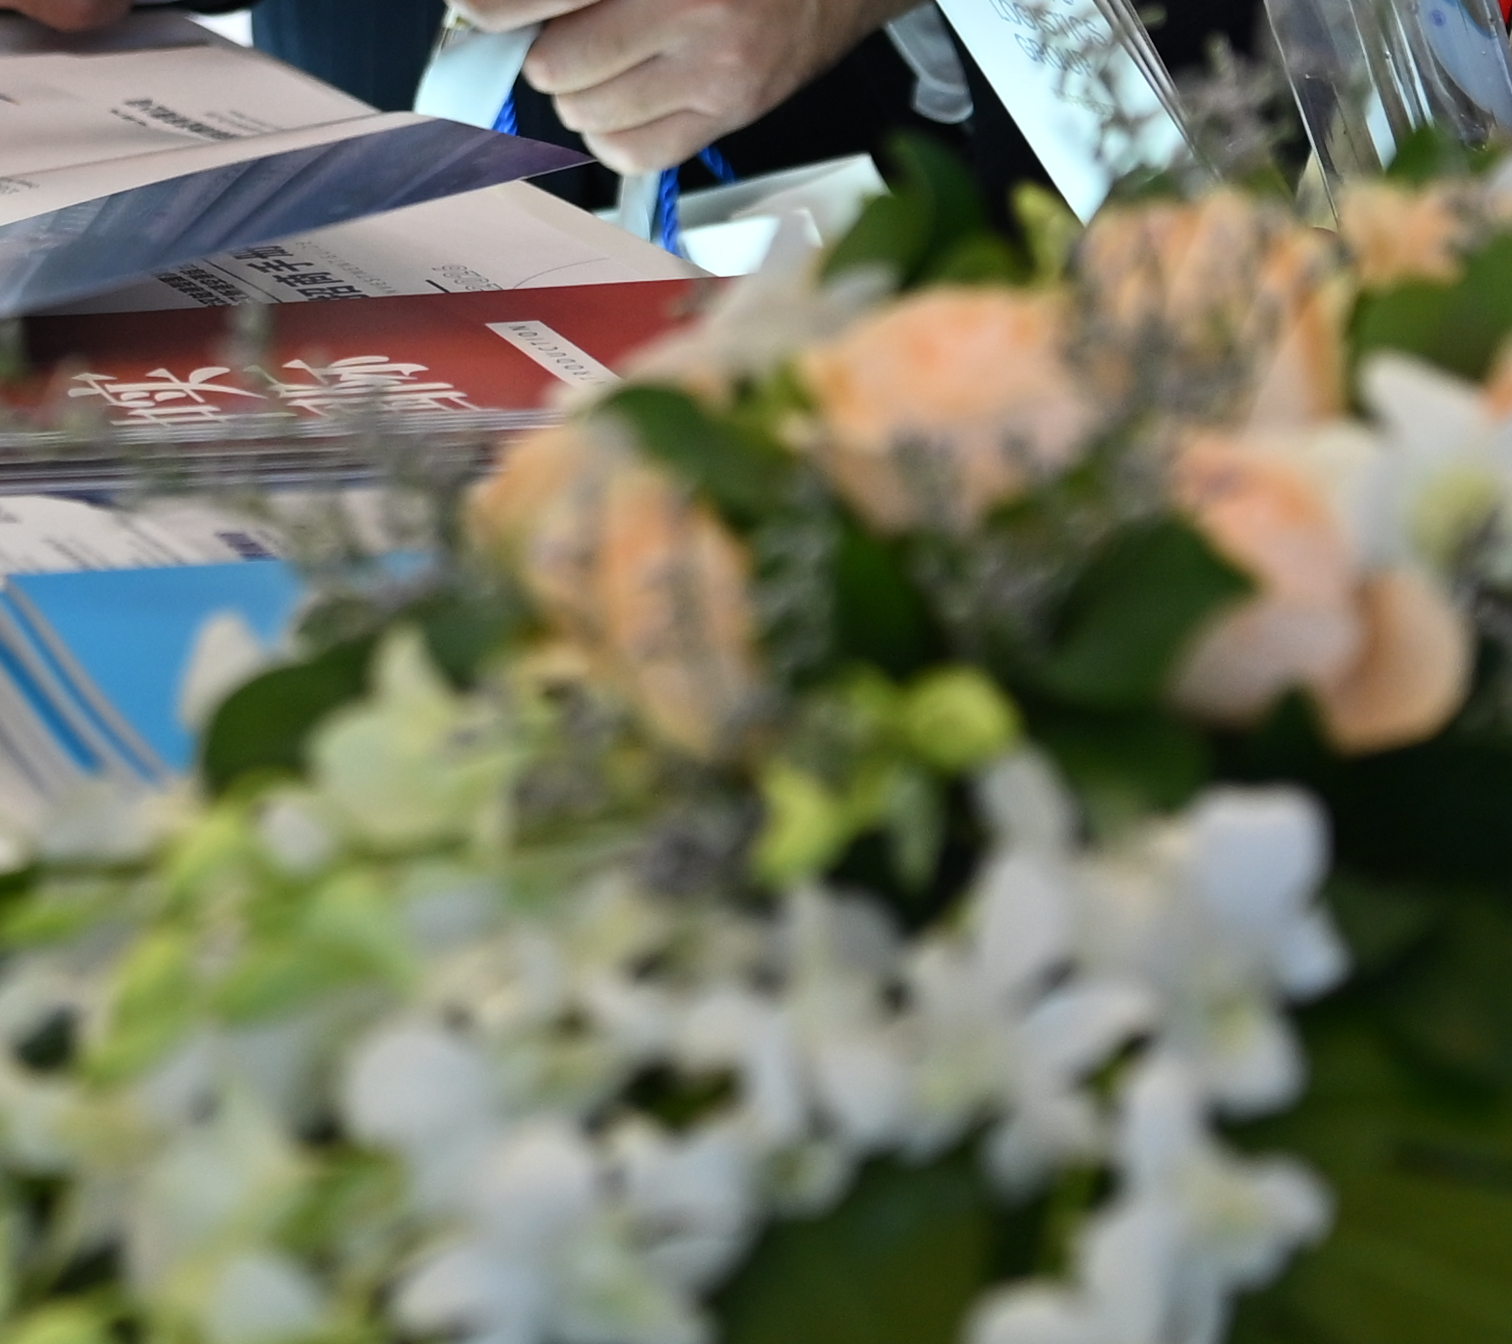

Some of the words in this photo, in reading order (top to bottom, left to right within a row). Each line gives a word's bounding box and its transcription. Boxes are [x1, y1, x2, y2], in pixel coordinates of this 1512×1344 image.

[229, 245, 369, 301] 招商手册
[508, 324, 606, 386] TRODUCTION
